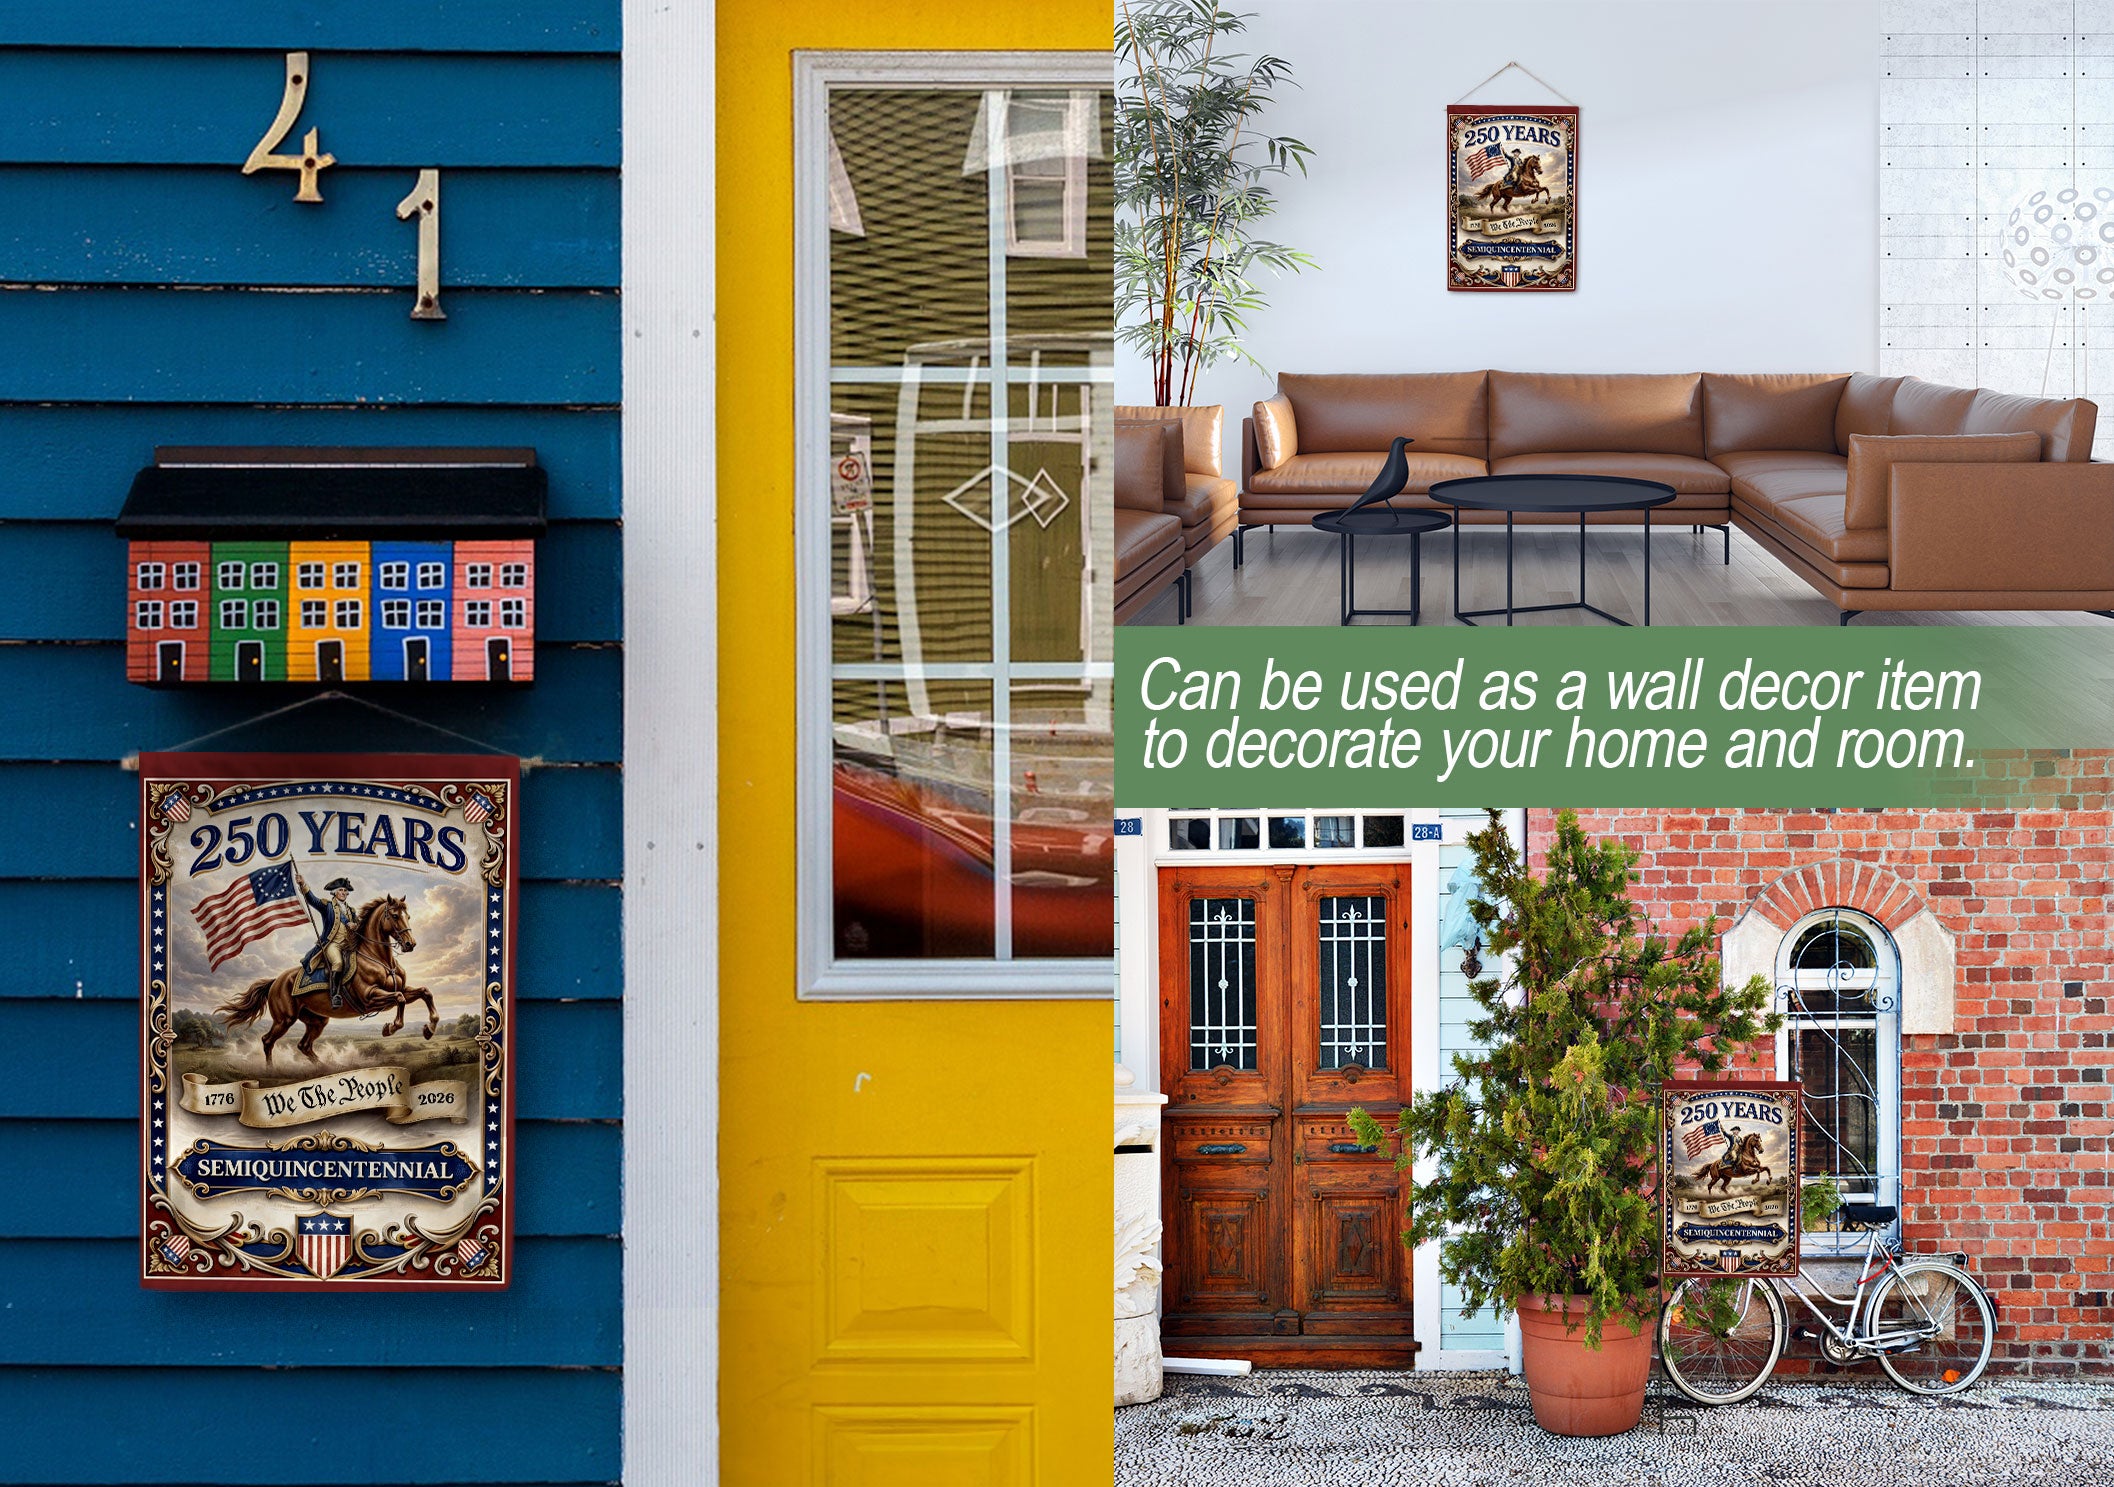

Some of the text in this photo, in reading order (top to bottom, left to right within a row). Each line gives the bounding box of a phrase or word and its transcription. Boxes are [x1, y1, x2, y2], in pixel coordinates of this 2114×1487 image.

[1464, 124, 1561, 148] 250 YEARS
[1467, 245, 1556, 254] SEMIQUINCENTENNIAL
[1120, 821, 1134, 833] 28
[1414, 827, 1440, 839] 28-A
[189, 810, 467, 878] 250 YEARS
[204, 1073, 455, 1119] 1776 We The People 2026
[1680, 1101, 1783, 1126] 250 YEARS
[197, 1159, 454, 1181] SEMIQUINCENTENNIAL
[1683, 1229, 1779, 1239] SEMIQUINCENTENNIAL
